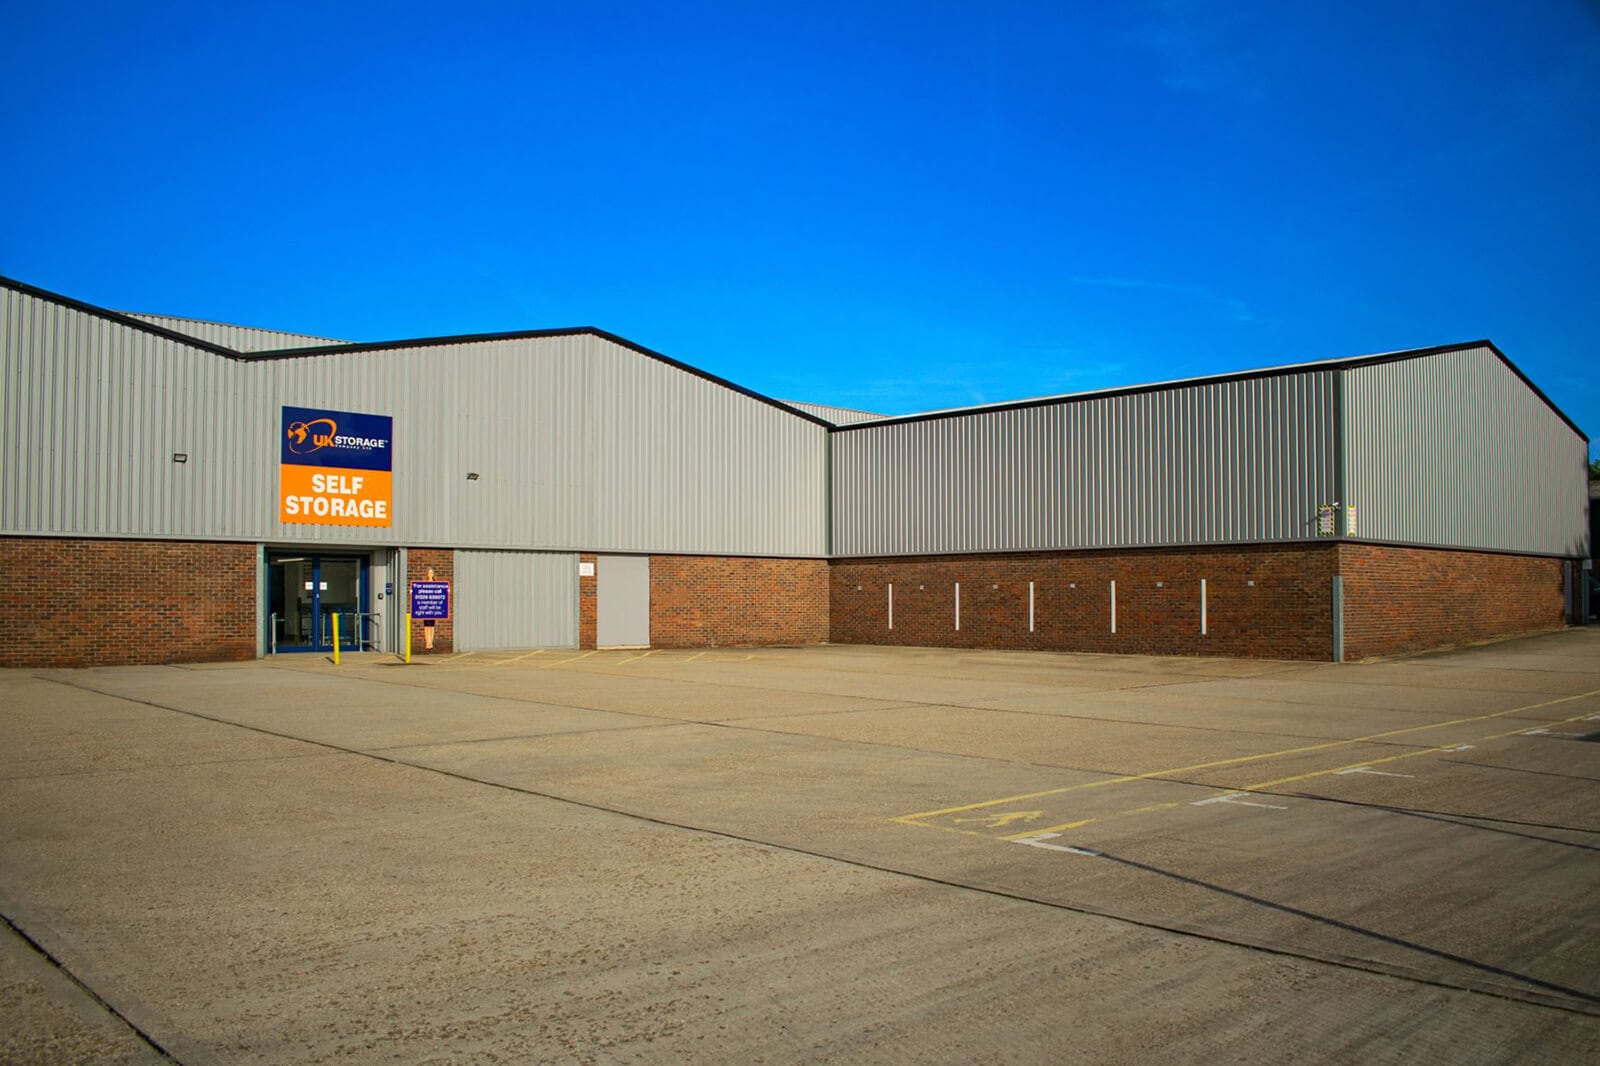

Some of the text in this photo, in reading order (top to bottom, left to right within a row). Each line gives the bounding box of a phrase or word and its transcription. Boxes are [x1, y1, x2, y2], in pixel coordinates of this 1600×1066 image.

[313, 434, 385, 448] UK STORAGE
[312, 473, 364, 495] SELF
[285, 495, 387, 519] STORAGE
